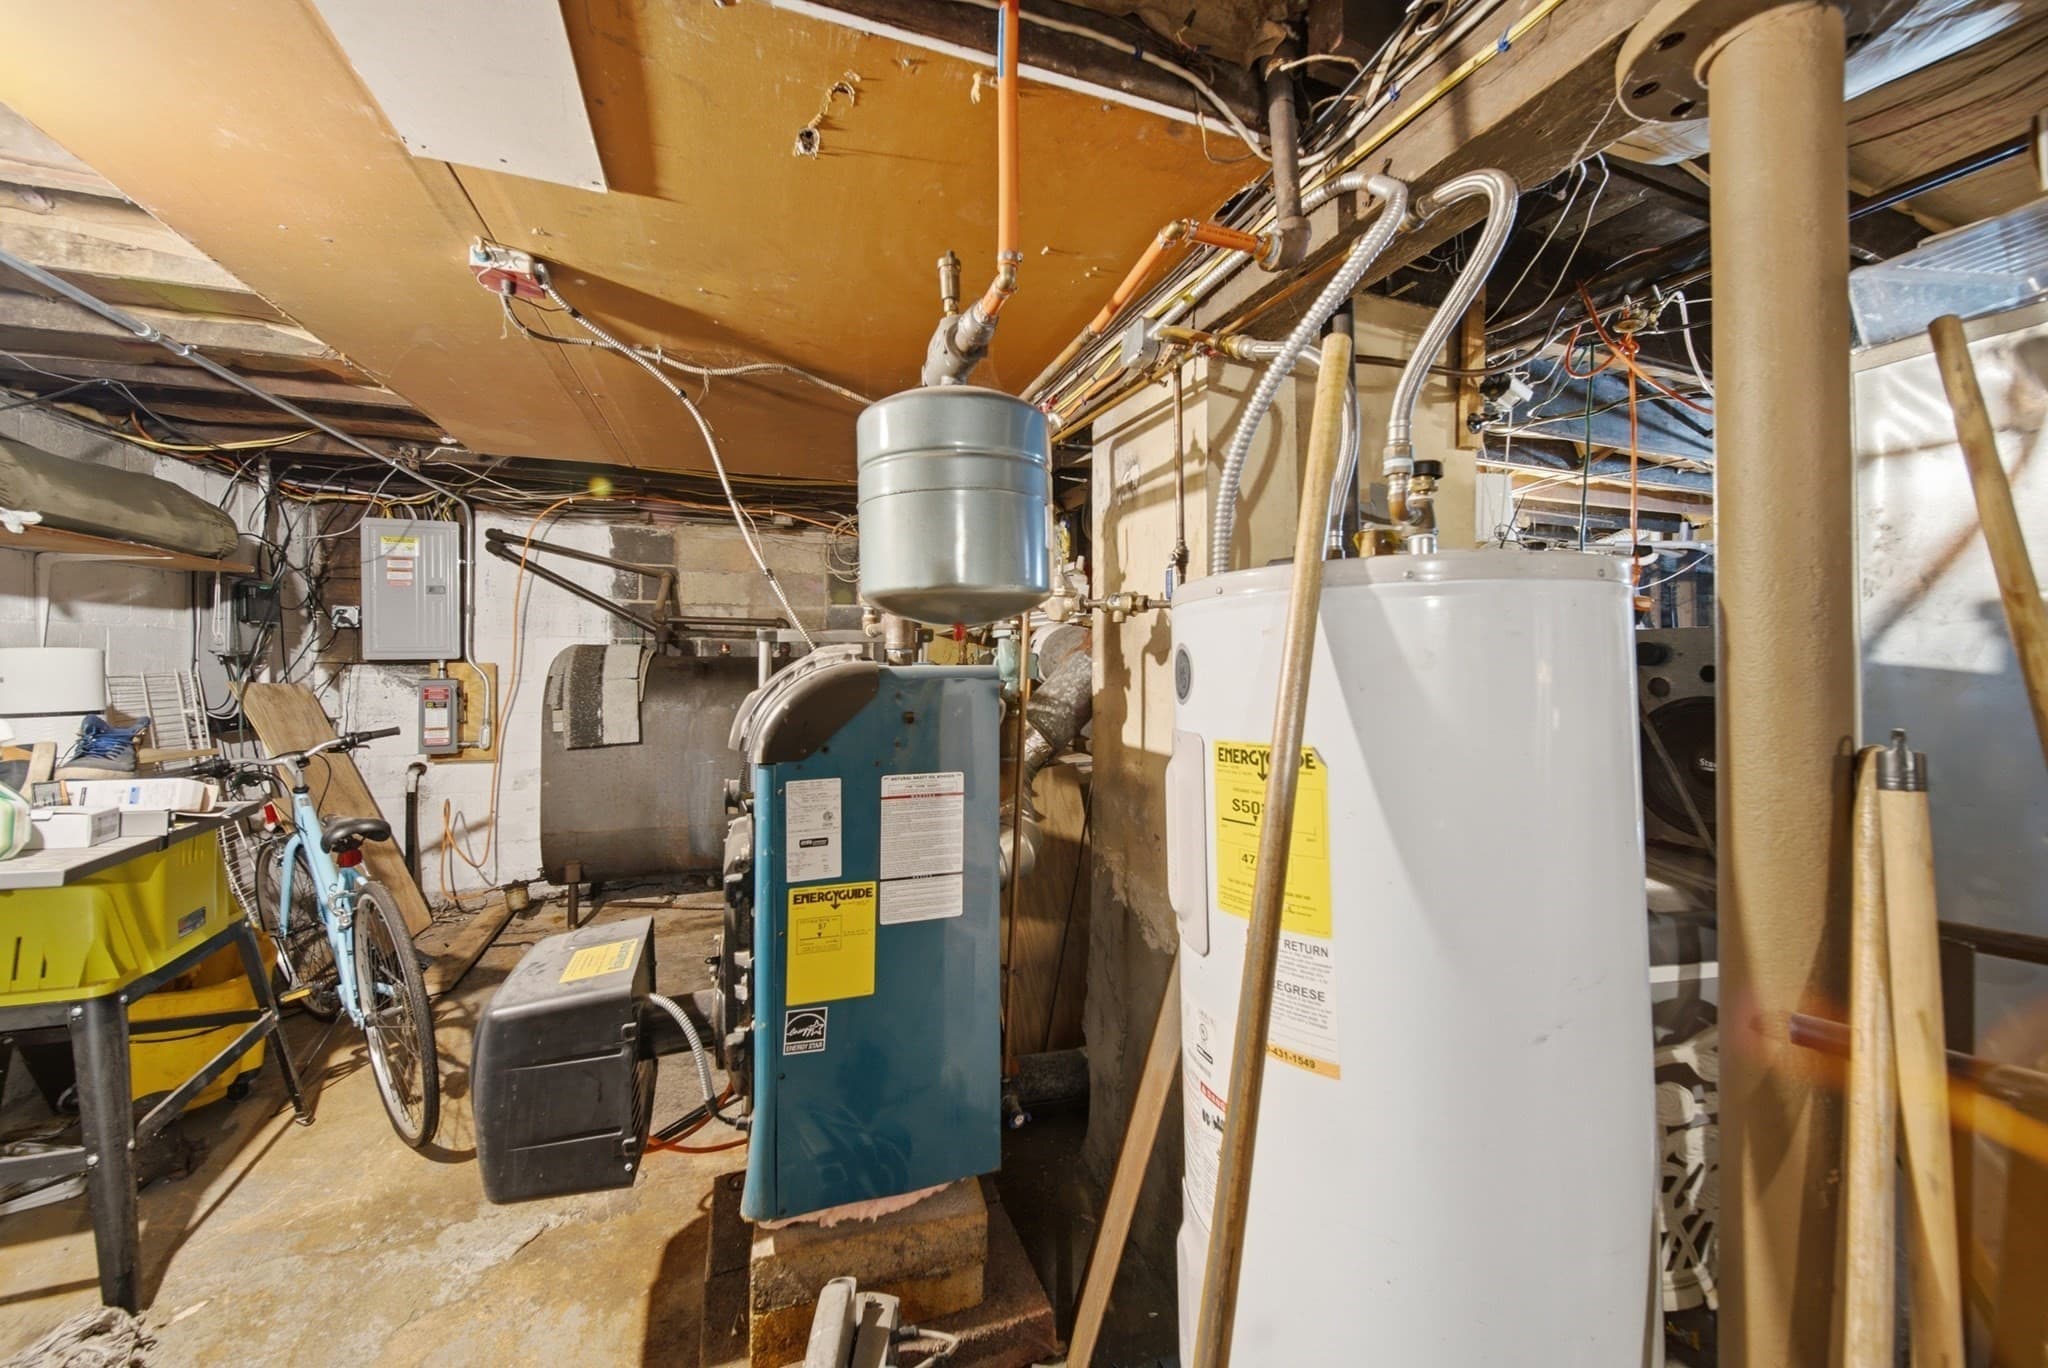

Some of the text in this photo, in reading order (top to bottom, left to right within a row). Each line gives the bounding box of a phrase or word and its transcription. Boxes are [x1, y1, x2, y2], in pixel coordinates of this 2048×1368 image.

[793, 888, 873, 905] ENERGYGUIDE
[1284, 939, 1329, 958] RETURN
[1274, 979, 1325, 1002] EGRESE
